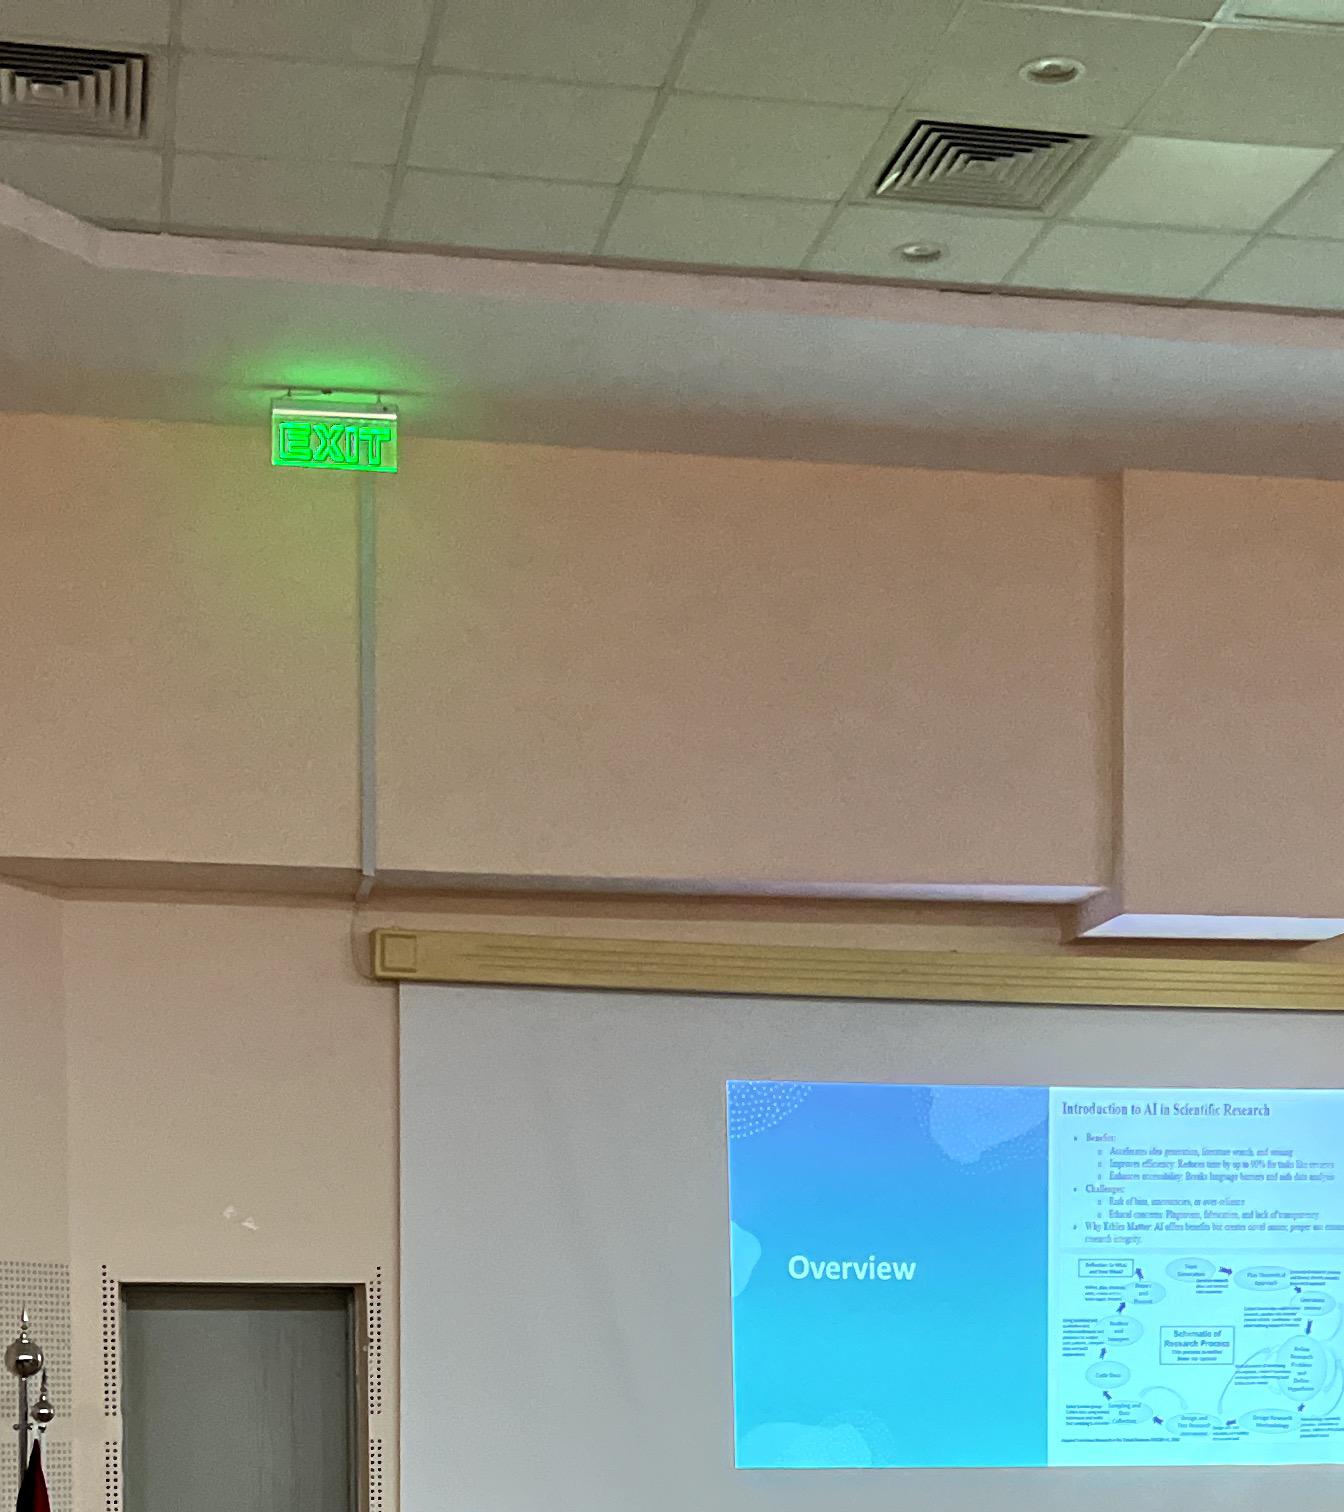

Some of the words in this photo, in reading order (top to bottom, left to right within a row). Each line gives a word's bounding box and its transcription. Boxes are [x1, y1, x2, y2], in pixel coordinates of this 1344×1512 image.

[279, 421, 391, 465] EXIT
[1062, 1102, 1128, 1115] Introduction
[1131, 1104, 1141, 1115] to
[1144, 1103, 1158, 1115] AI
[1160, 1104, 1170, 1115] in
[1173, 1103, 1221, 1116] Scientific
[1223, 1103, 1271, 1116] Research
[788, 1254, 917, 1281] Overview
